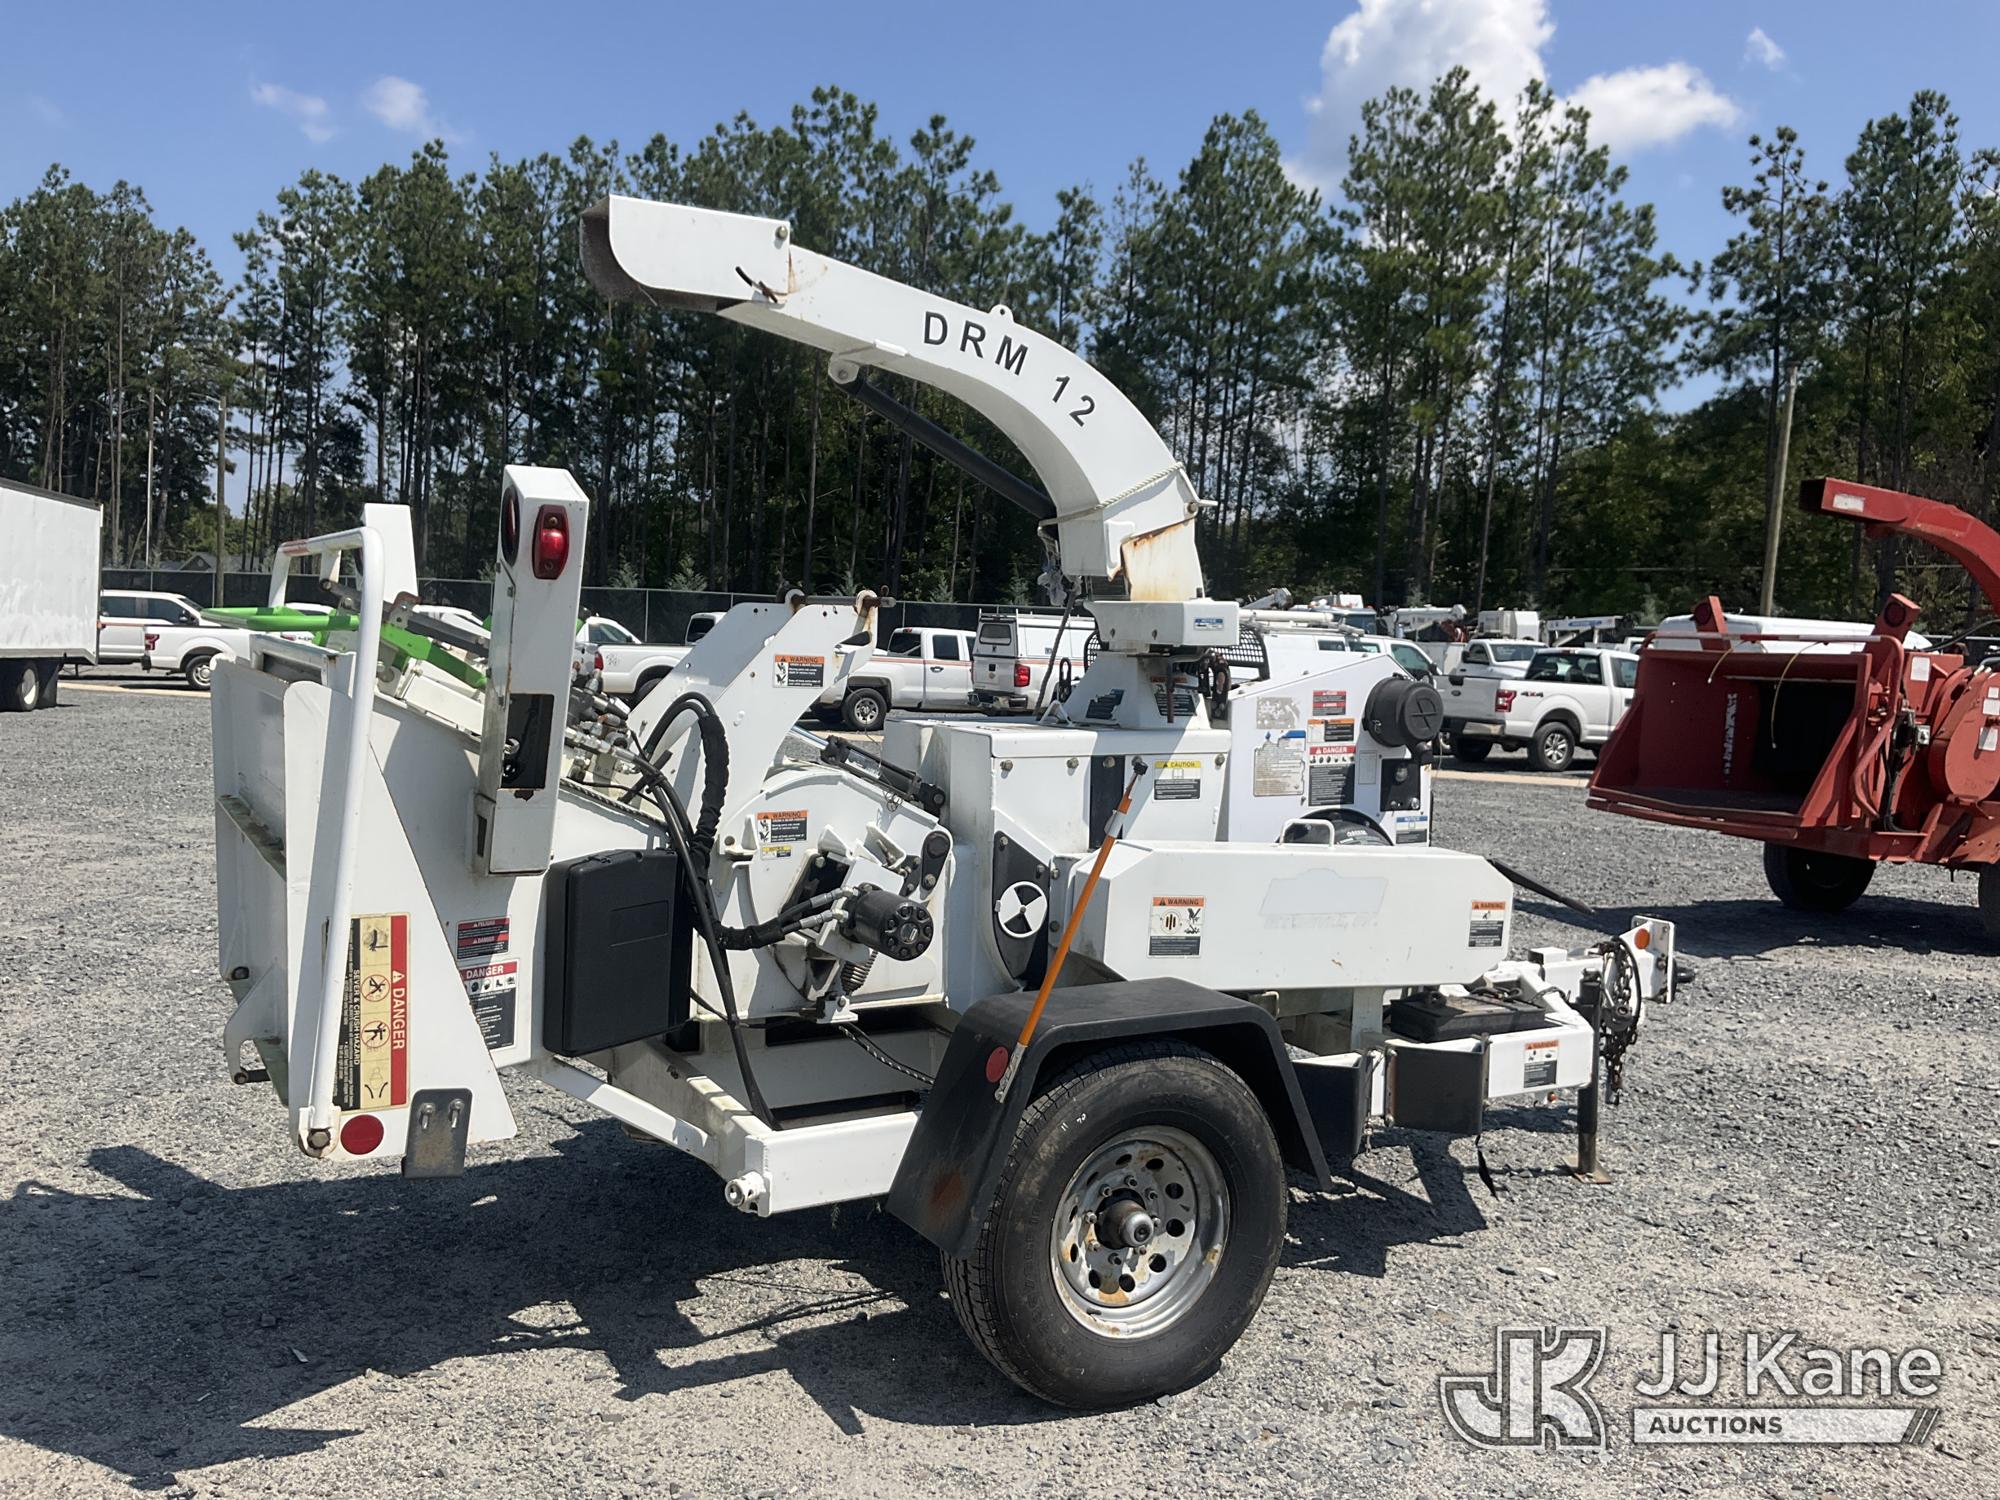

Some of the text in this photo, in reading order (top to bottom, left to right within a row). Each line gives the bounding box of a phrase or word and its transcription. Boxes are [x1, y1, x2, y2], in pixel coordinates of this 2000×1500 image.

[924, 311, 1096, 427] DRM 12
[466, 965, 504, 979] DANGER
[392, 988, 406, 1049] DANGER
